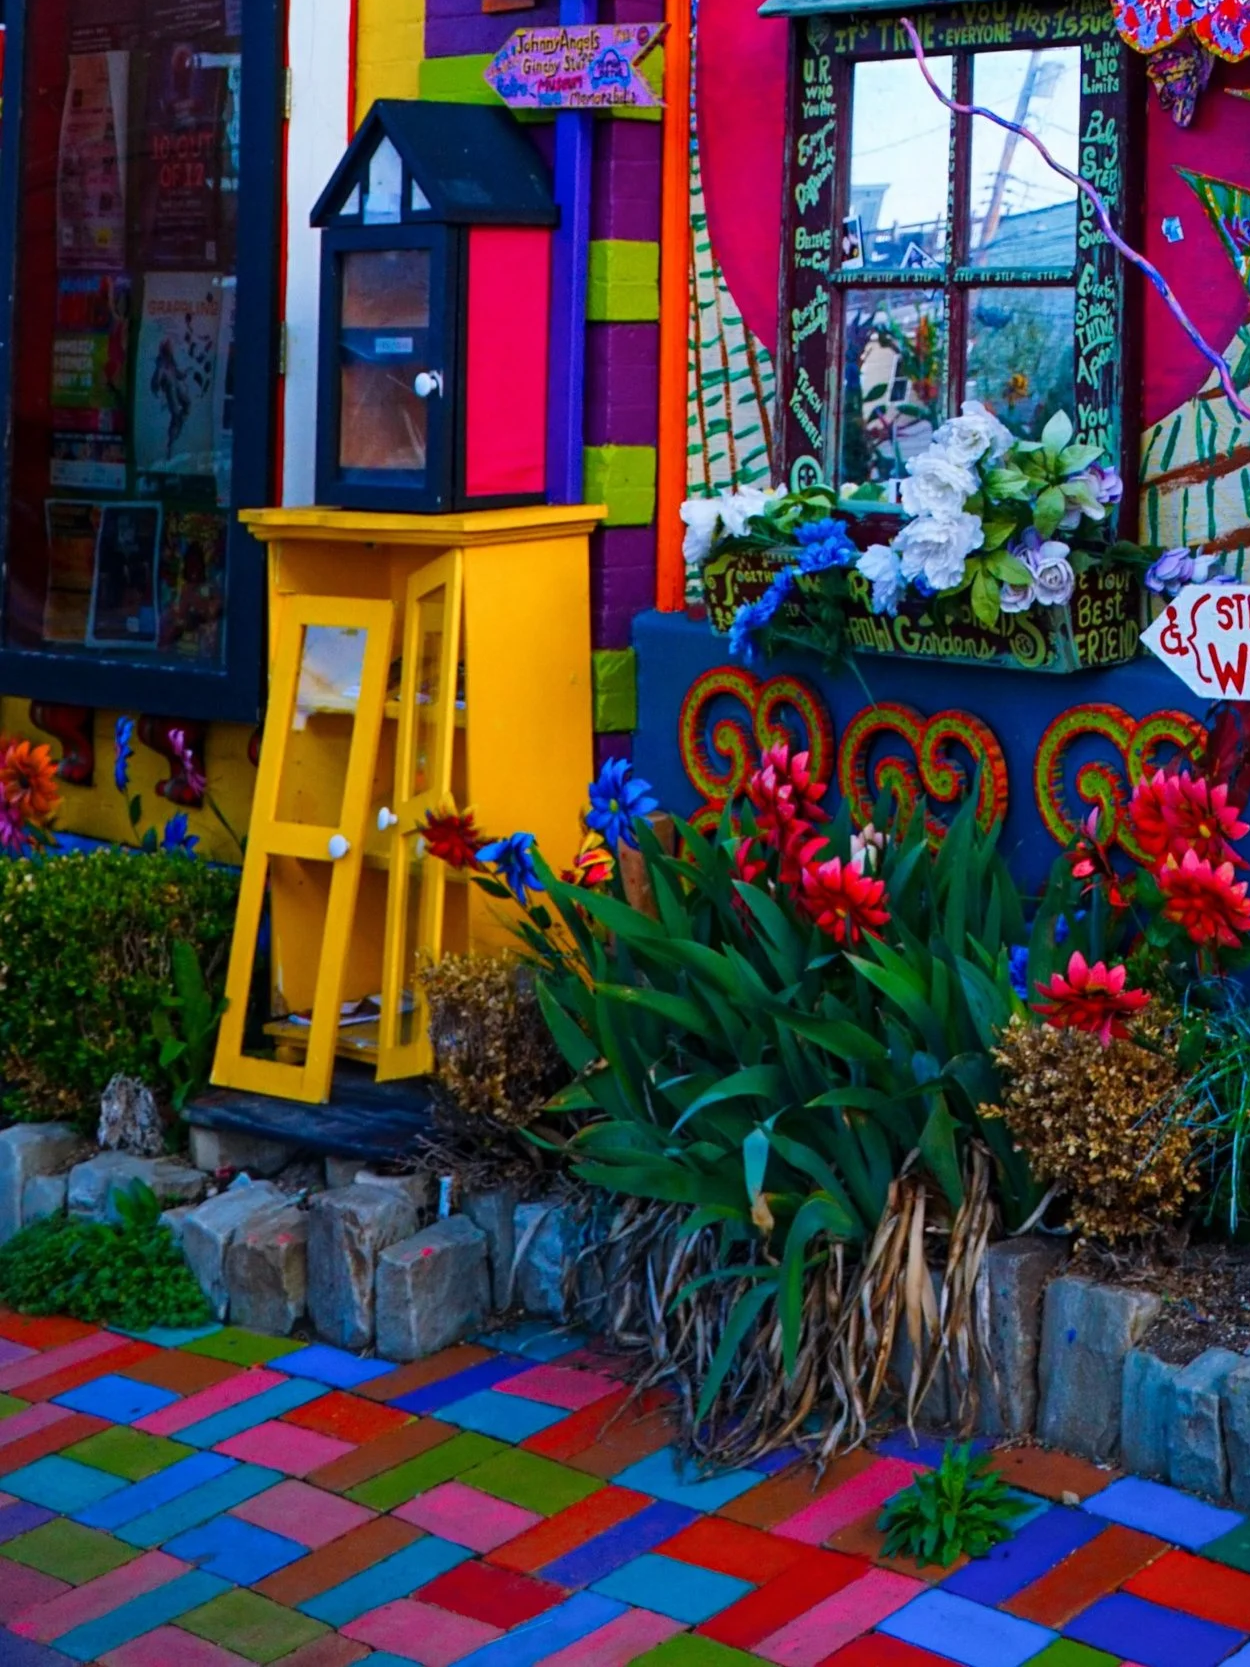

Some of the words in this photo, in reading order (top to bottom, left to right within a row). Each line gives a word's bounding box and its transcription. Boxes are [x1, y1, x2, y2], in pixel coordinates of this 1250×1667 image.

[945, 21, 1013, 47] EVERYONE
[1095, 59, 1117, 77] NO
[1082, 73, 1119, 95] Limits
[797, 366, 823, 414] TEACH
[1077, 591, 1126, 630] Best
